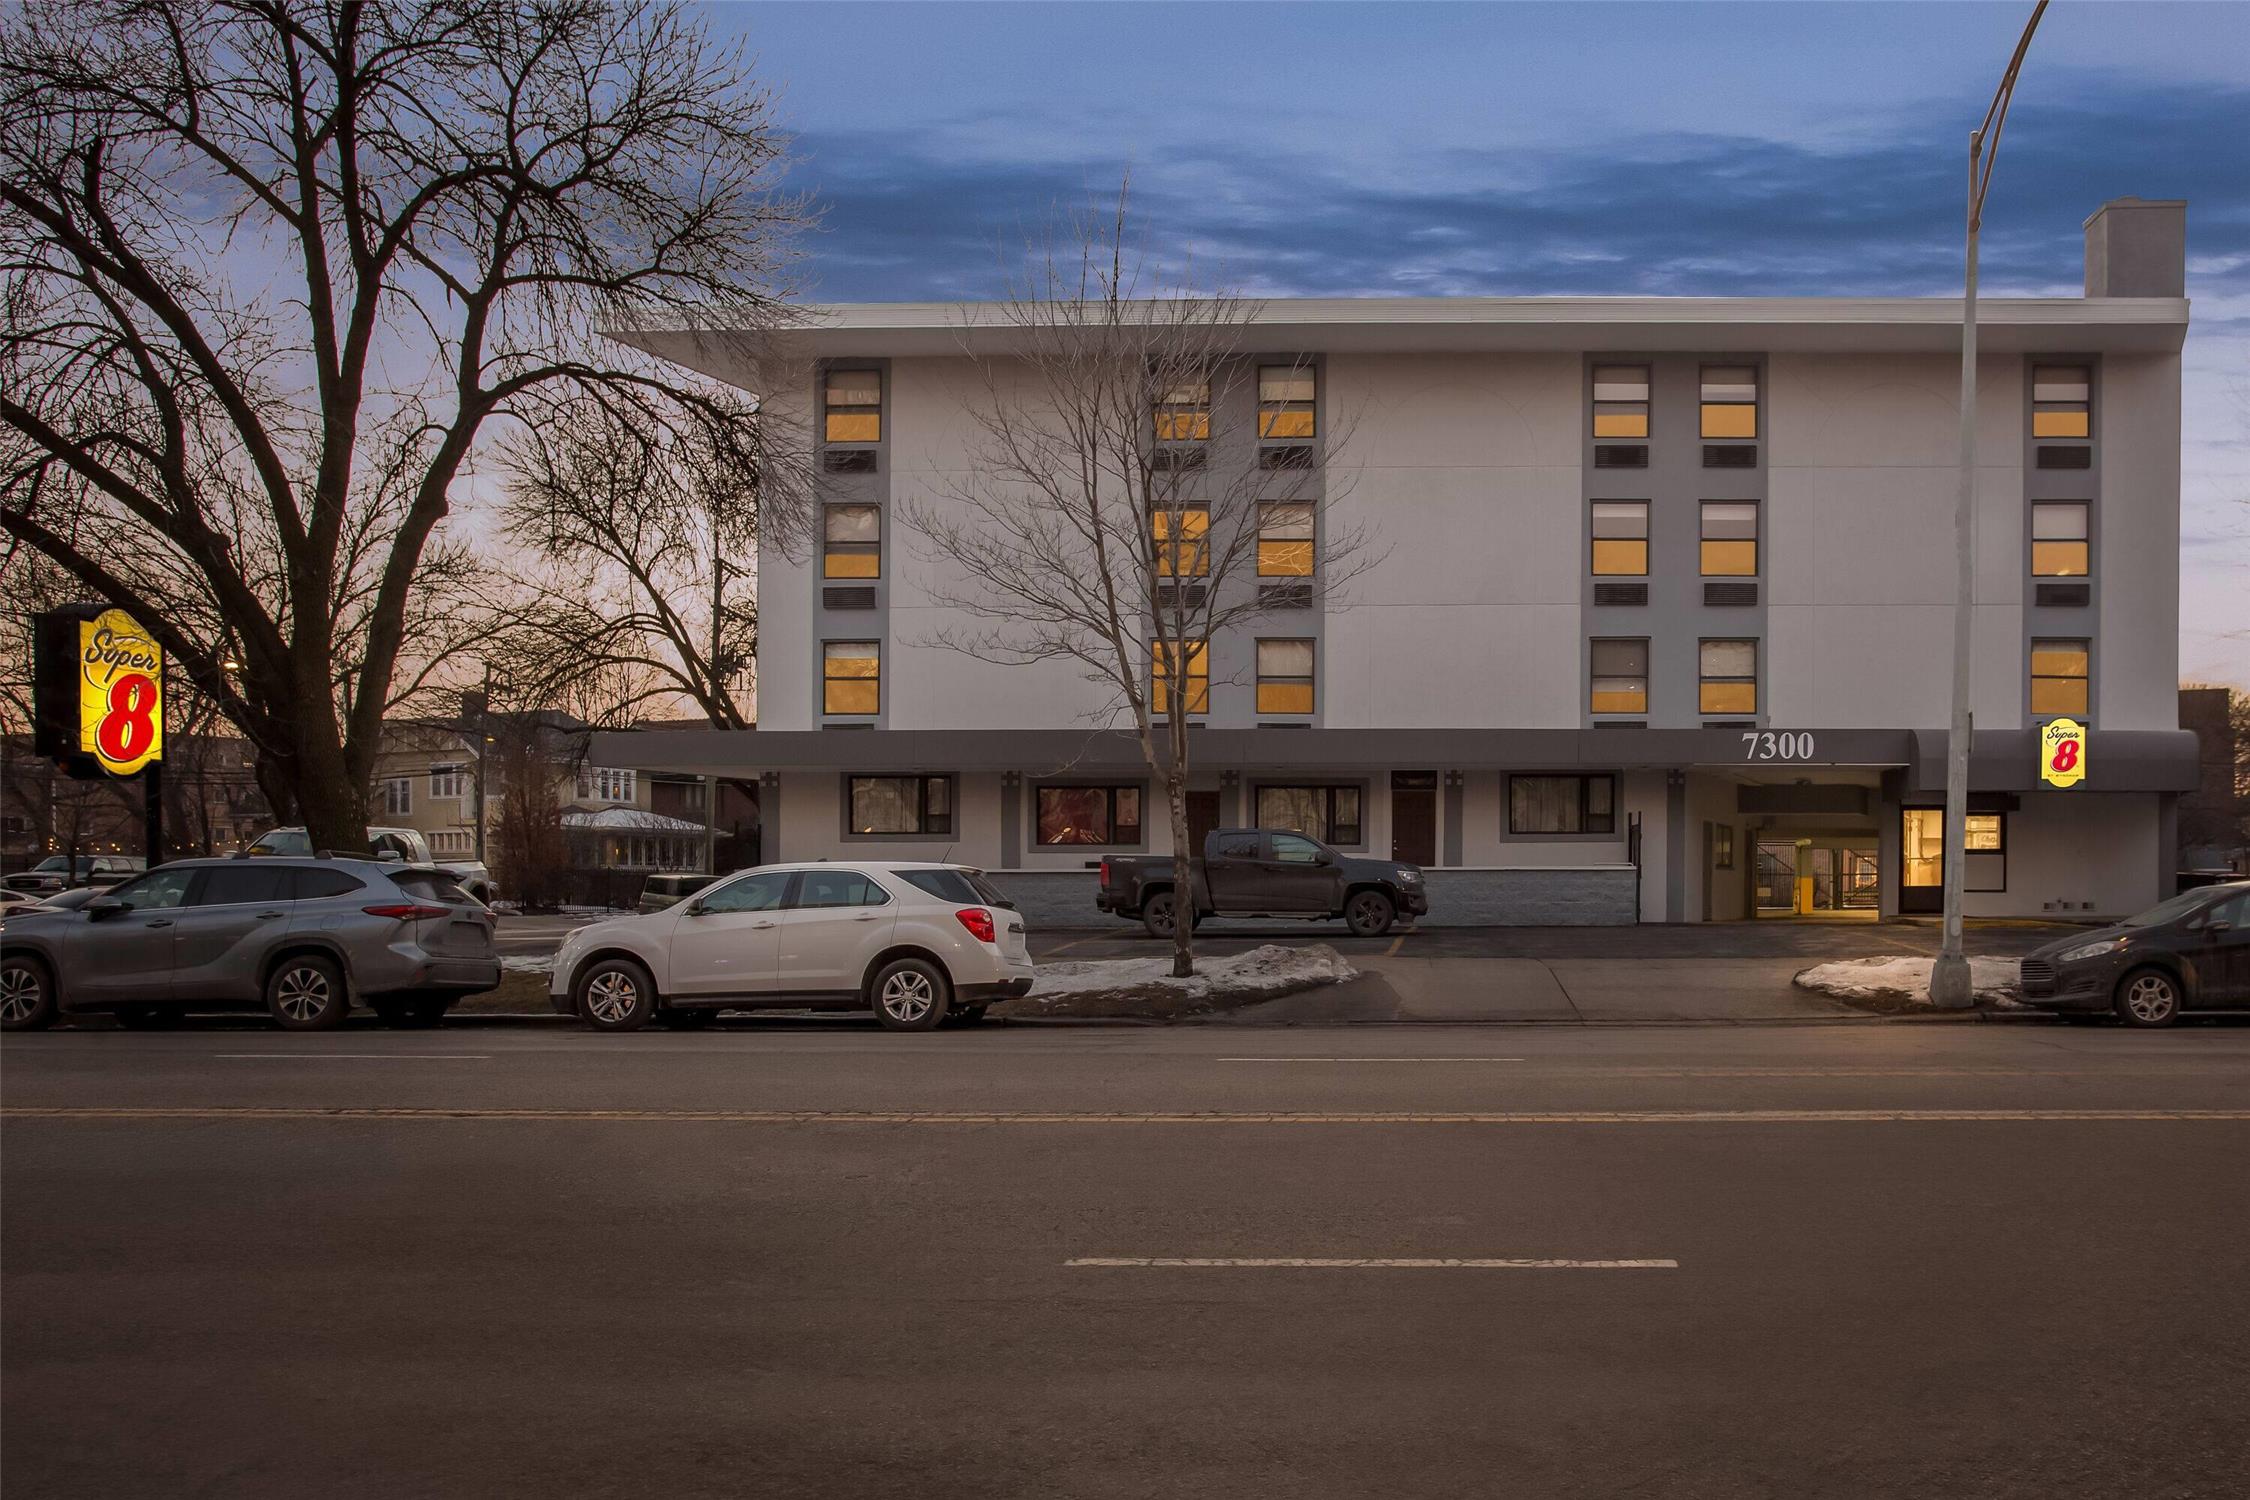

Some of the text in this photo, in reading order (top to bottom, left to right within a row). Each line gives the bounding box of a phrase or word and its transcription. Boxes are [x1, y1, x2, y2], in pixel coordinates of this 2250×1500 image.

[84, 627, 158, 683] Super
[95, 673, 157, 763] 8
[1742, 732, 1814, 759] 7300
[2046, 726, 2080, 745] Super
[2050, 740, 2079, 772] 8
